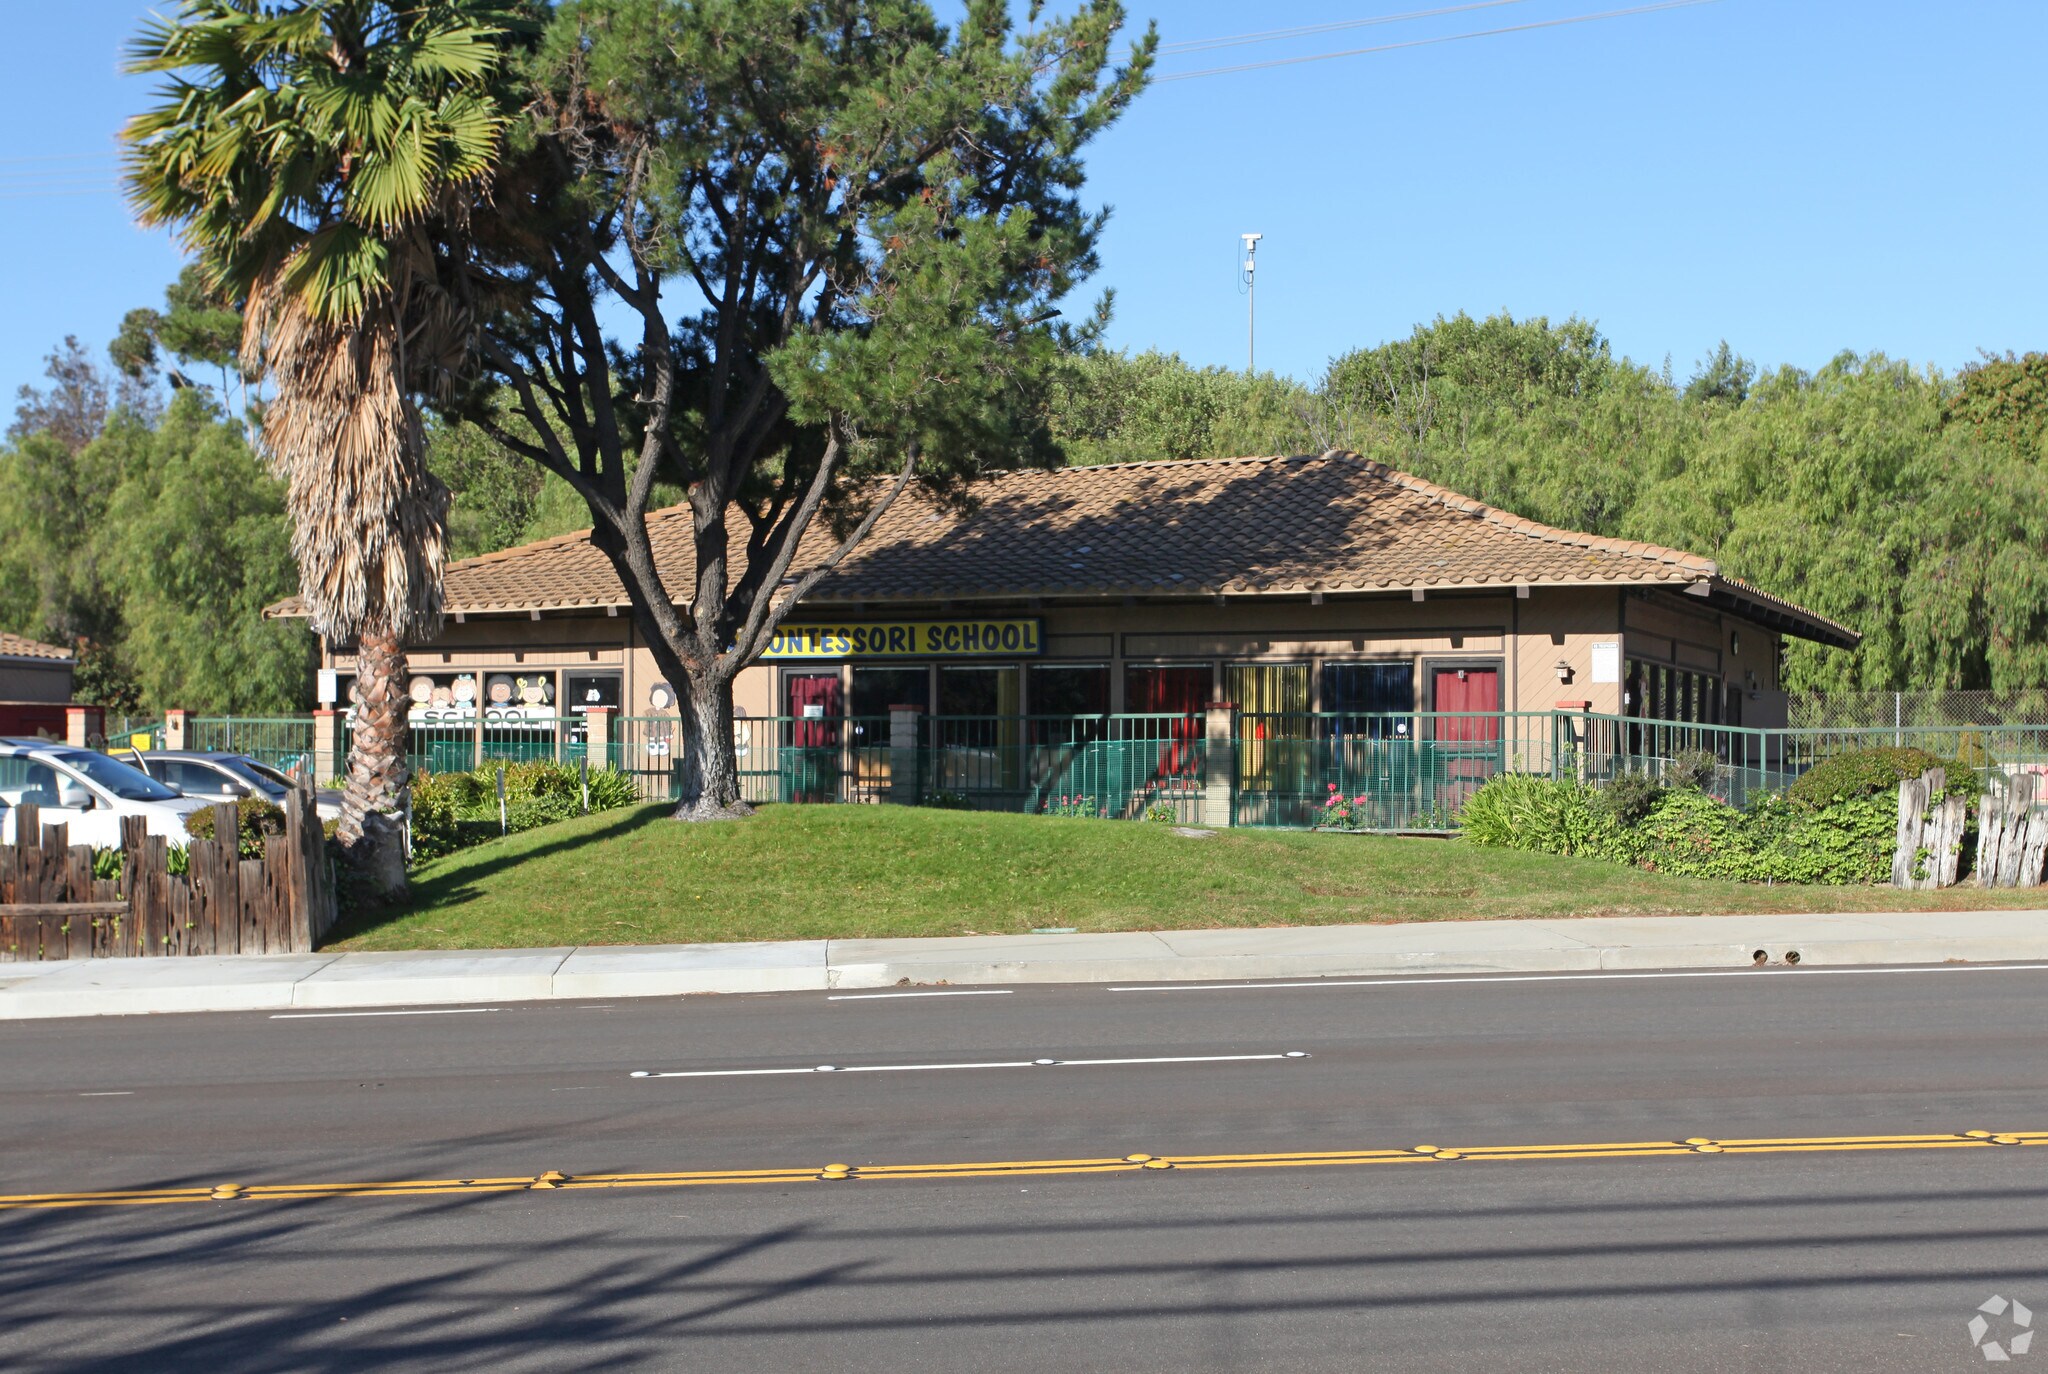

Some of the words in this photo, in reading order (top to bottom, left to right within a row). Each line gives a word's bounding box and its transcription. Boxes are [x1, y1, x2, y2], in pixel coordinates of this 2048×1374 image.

[767, 625, 916, 654] ONTESSORI
[926, 622, 1037, 652] SCHOOL
[424, 710, 540, 725] SCHOOL
